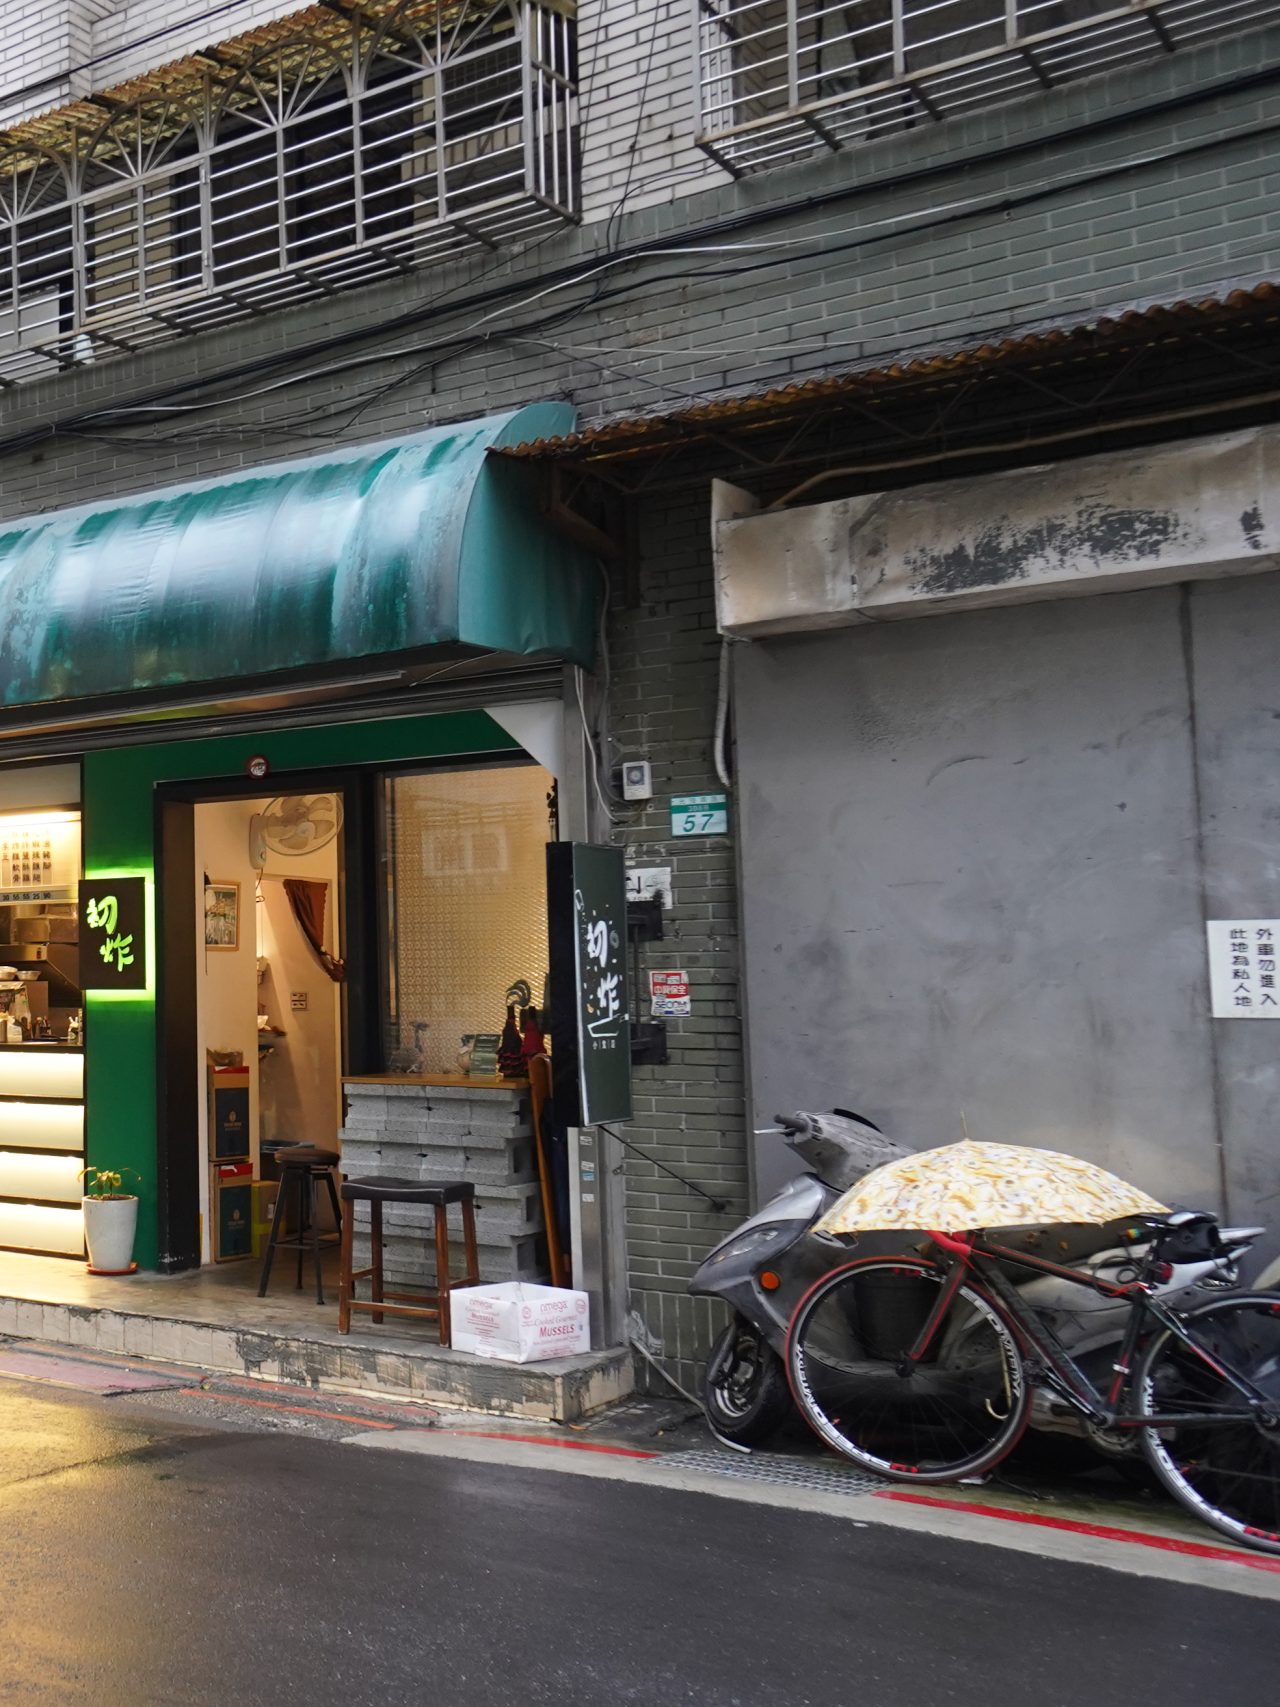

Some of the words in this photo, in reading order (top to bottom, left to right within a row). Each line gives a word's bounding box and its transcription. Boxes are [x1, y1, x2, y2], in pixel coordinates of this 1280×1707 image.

[682, 813, 714, 833] 57
[86, 895, 134, 972] 初炸
[539, 1324, 575, 1338] MUSSELS
